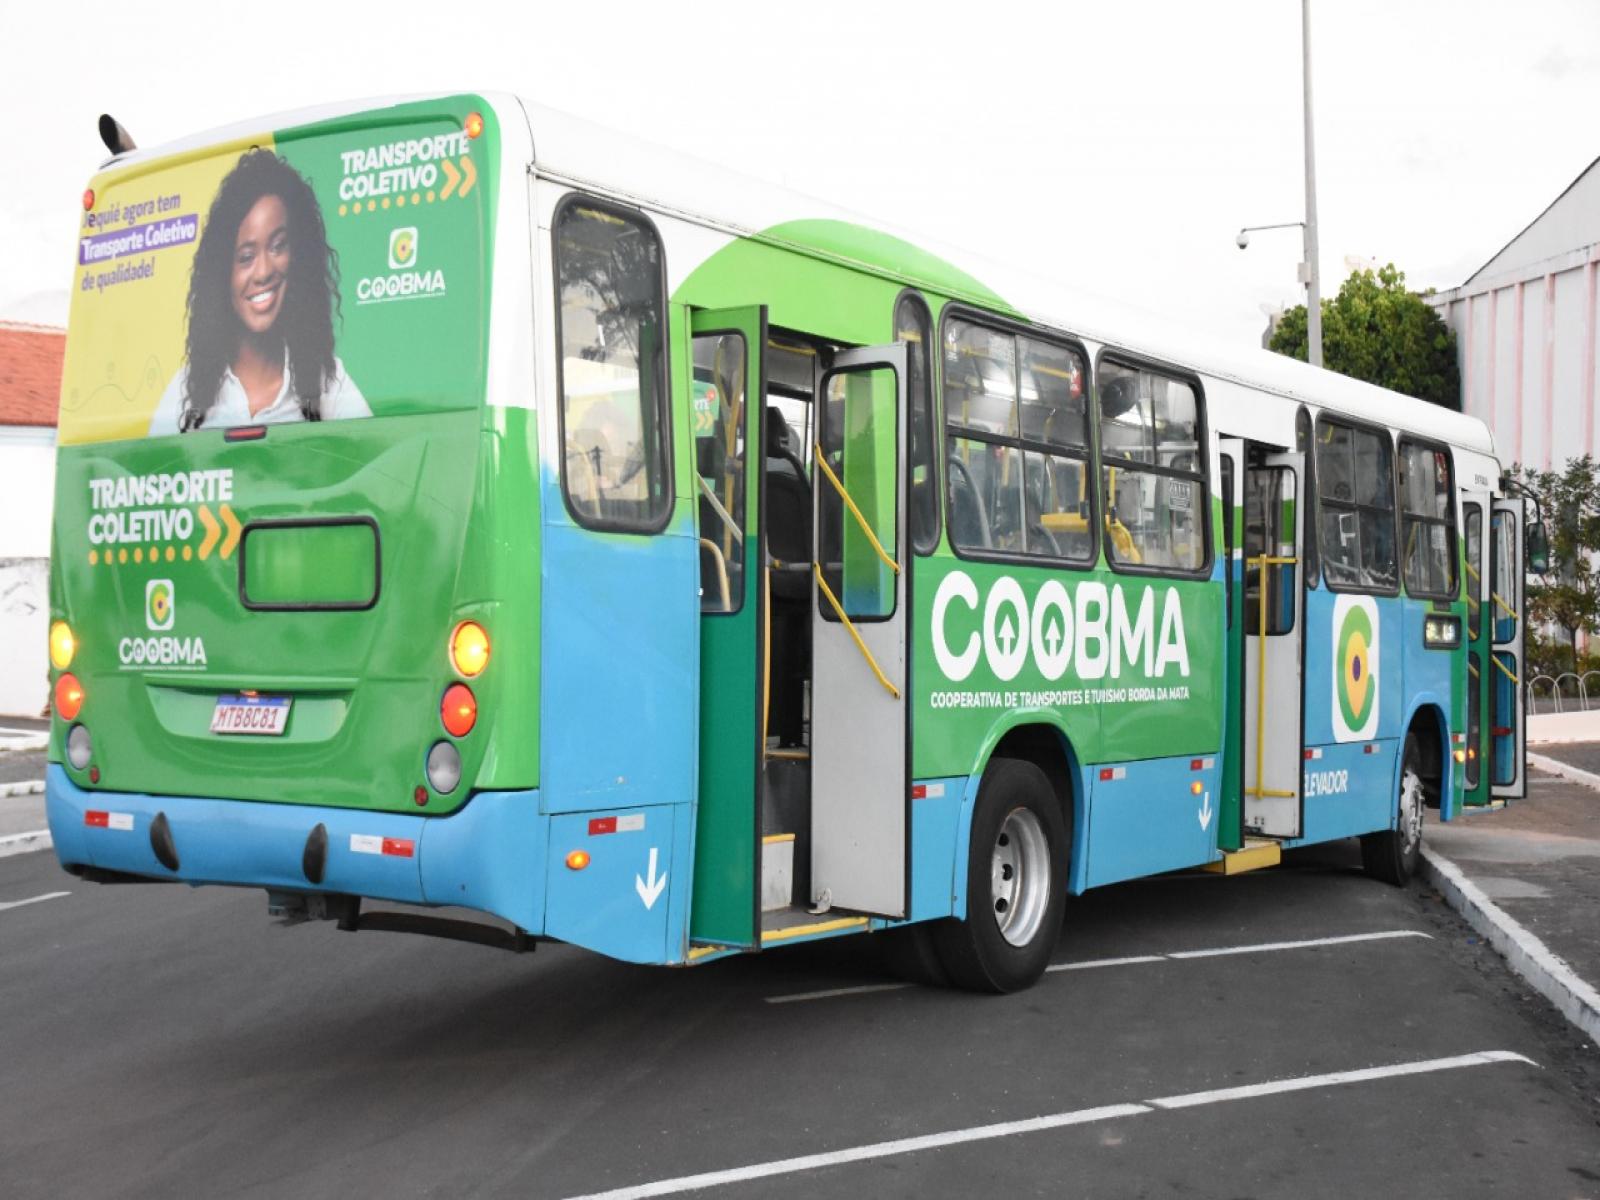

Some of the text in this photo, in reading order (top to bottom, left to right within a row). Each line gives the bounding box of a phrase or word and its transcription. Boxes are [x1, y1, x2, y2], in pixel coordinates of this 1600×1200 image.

[340, 130, 469, 175] TRANSPORTE
[339, 163, 438, 200] COLETIVO
[123, 200, 155, 225] agora
[157, 194, 181, 213] tem
[82, 218, 195, 259] Transporte Coletivo
[81, 256, 155, 294] de qualidade!
[357, 269, 446, 299] COOBMA
[89, 469, 233, 509] TRANSPORTE
[88, 508, 193, 544] COLETIVO
[931, 570, 1190, 681] COOBMA
[119, 637, 207, 665] COOBMA
[930, 686, 1190, 708] COOPERATIVA DE TRANSPORTES E TURISMO BORDA DA MATA
[1304, 769, 1348, 797] LEVADOR
